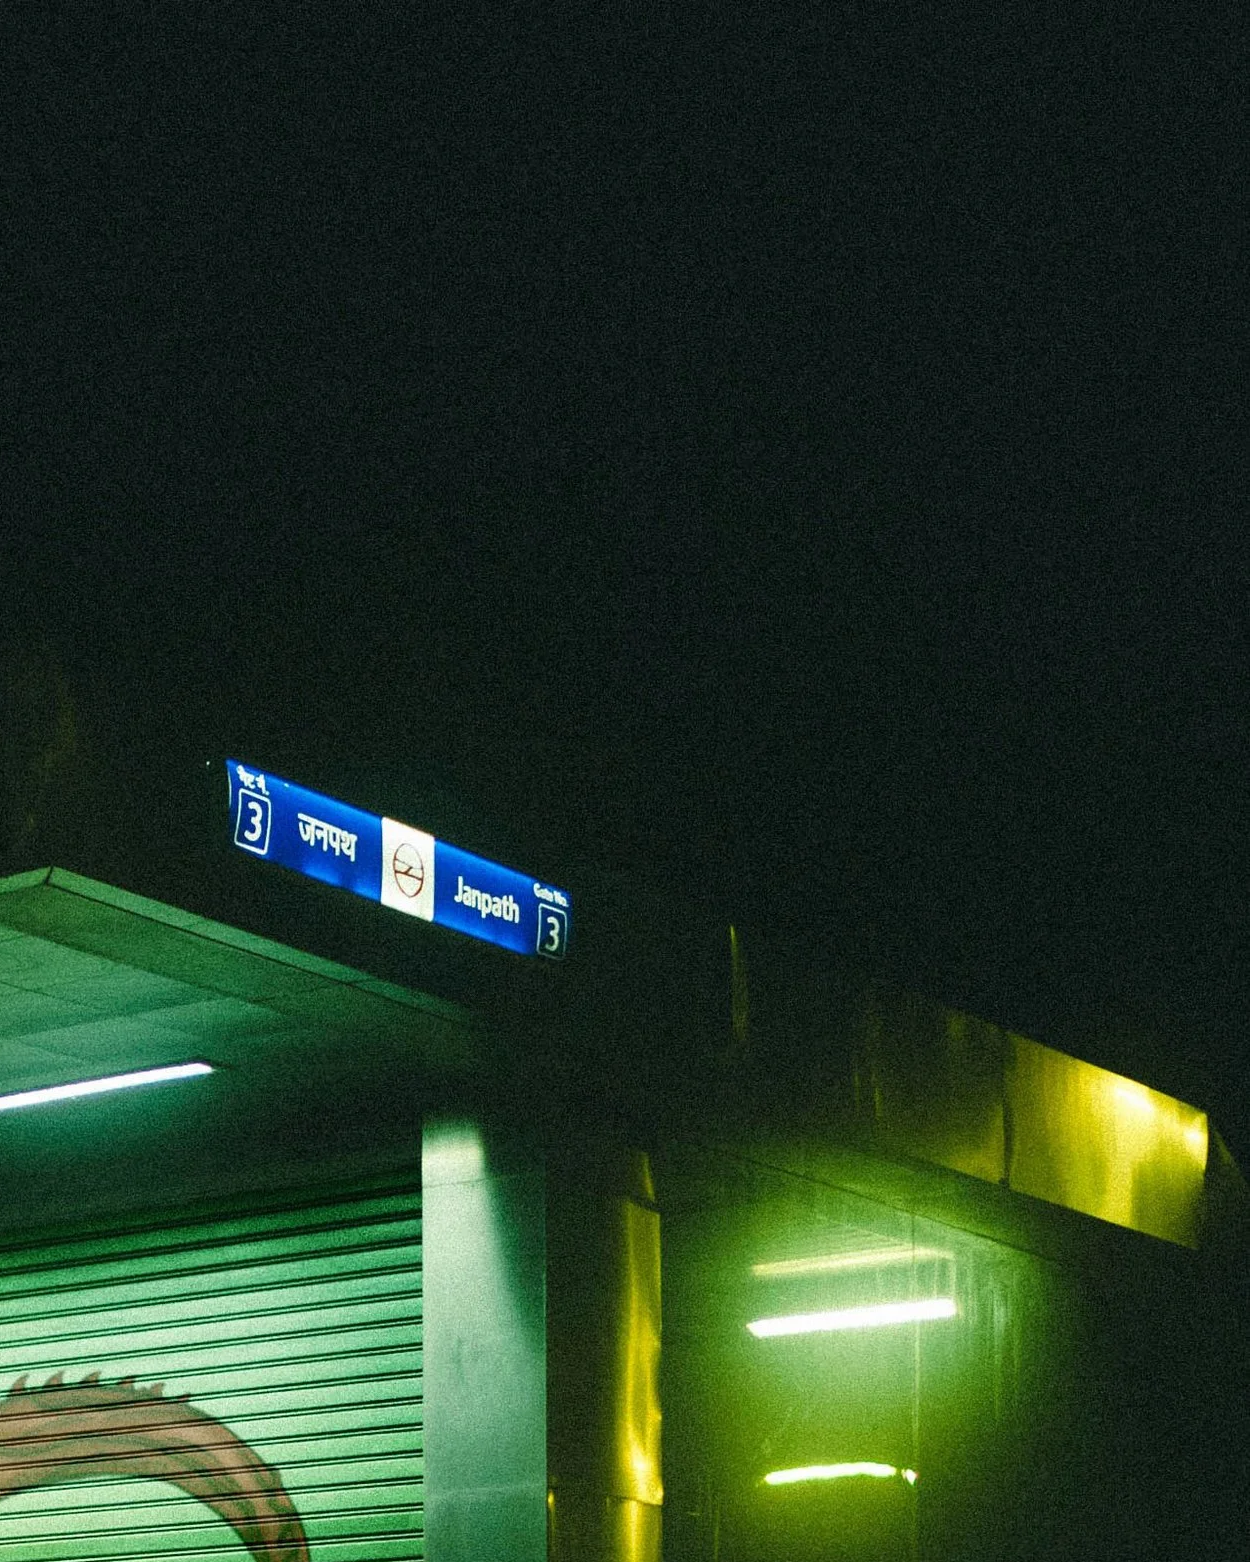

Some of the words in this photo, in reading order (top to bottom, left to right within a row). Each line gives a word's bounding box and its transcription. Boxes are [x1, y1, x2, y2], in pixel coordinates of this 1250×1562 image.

[244, 801, 263, 842] 3
[297, 812, 357, 862] जनपथ
[454, 875, 520, 924] Janpath
[545, 915, 560, 952] 3
